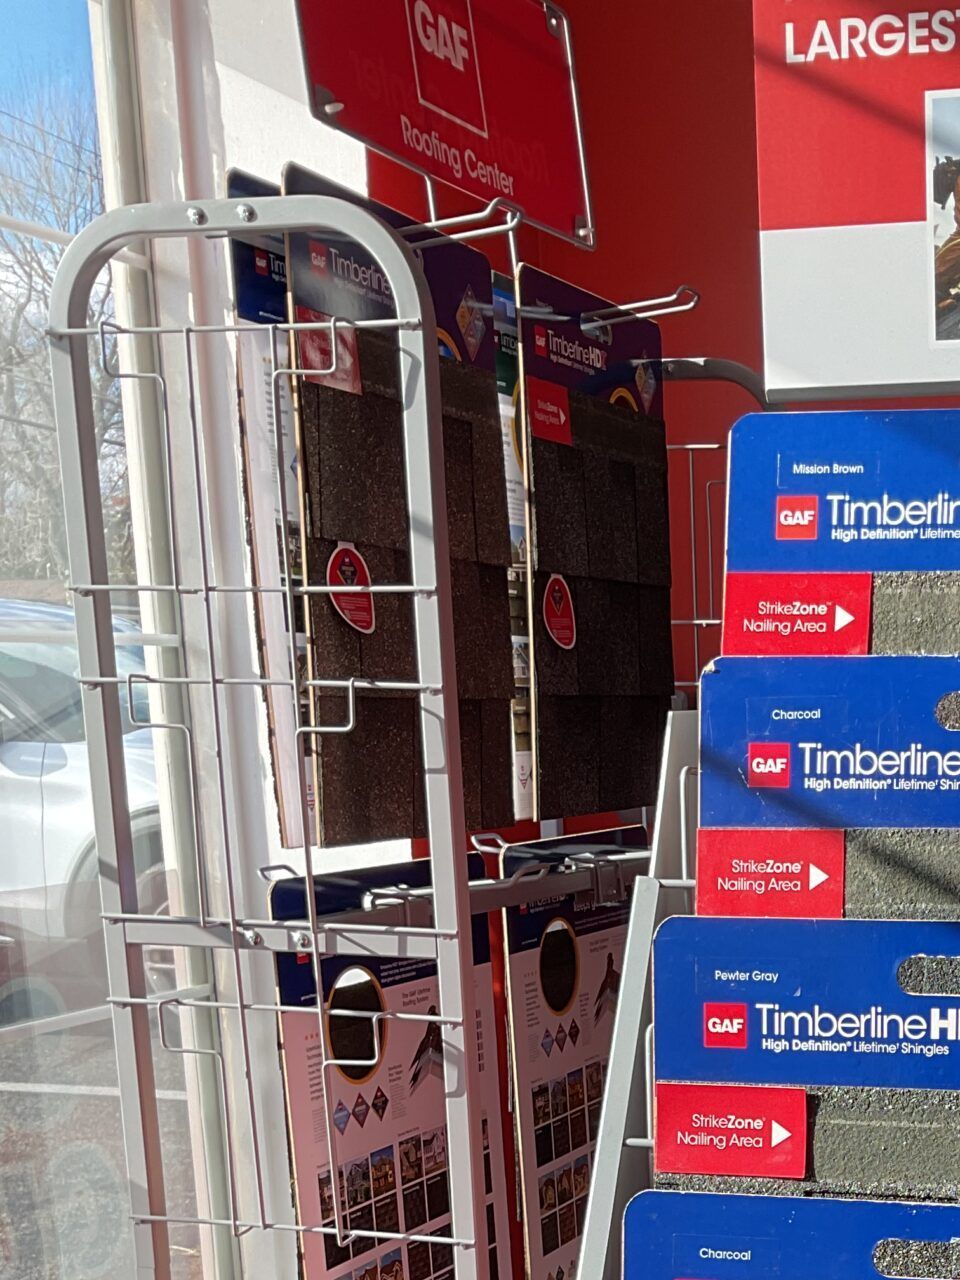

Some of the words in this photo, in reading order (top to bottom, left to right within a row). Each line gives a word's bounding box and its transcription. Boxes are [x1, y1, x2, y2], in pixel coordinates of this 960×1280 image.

[414, 0, 469, 72] GAF
[400, 114, 462, 179] Roofing
[464, 148, 514, 196] Center
[311, 252, 326, 268] GAF
[793, 463, 830, 474] Mission
[832, 463, 864, 474] Brown
[780, 510, 815, 525] GAF
[831, 528, 858, 543] High
[743, 619, 791, 635] Nailing
[793, 619, 826, 632] Area
[772, 709, 821, 720] Charcoal
[752, 757, 787, 773] GAF
[804, 777, 831, 791] High
[717, 877, 765, 894] Nailing
[768, 877, 801, 891] Area
[714, 970, 749, 981] Pewter
[752, 970, 779, 983] Gray
[707, 1017, 744, 1034] GAF
[762, 1038, 789, 1053] High
[901, 1043, 949, 1057] Shingles
[677, 1131, 727, 1150] Nailing
[729, 1133, 763, 1148] Area
[699, 1247, 751, 1260] Charcoal
